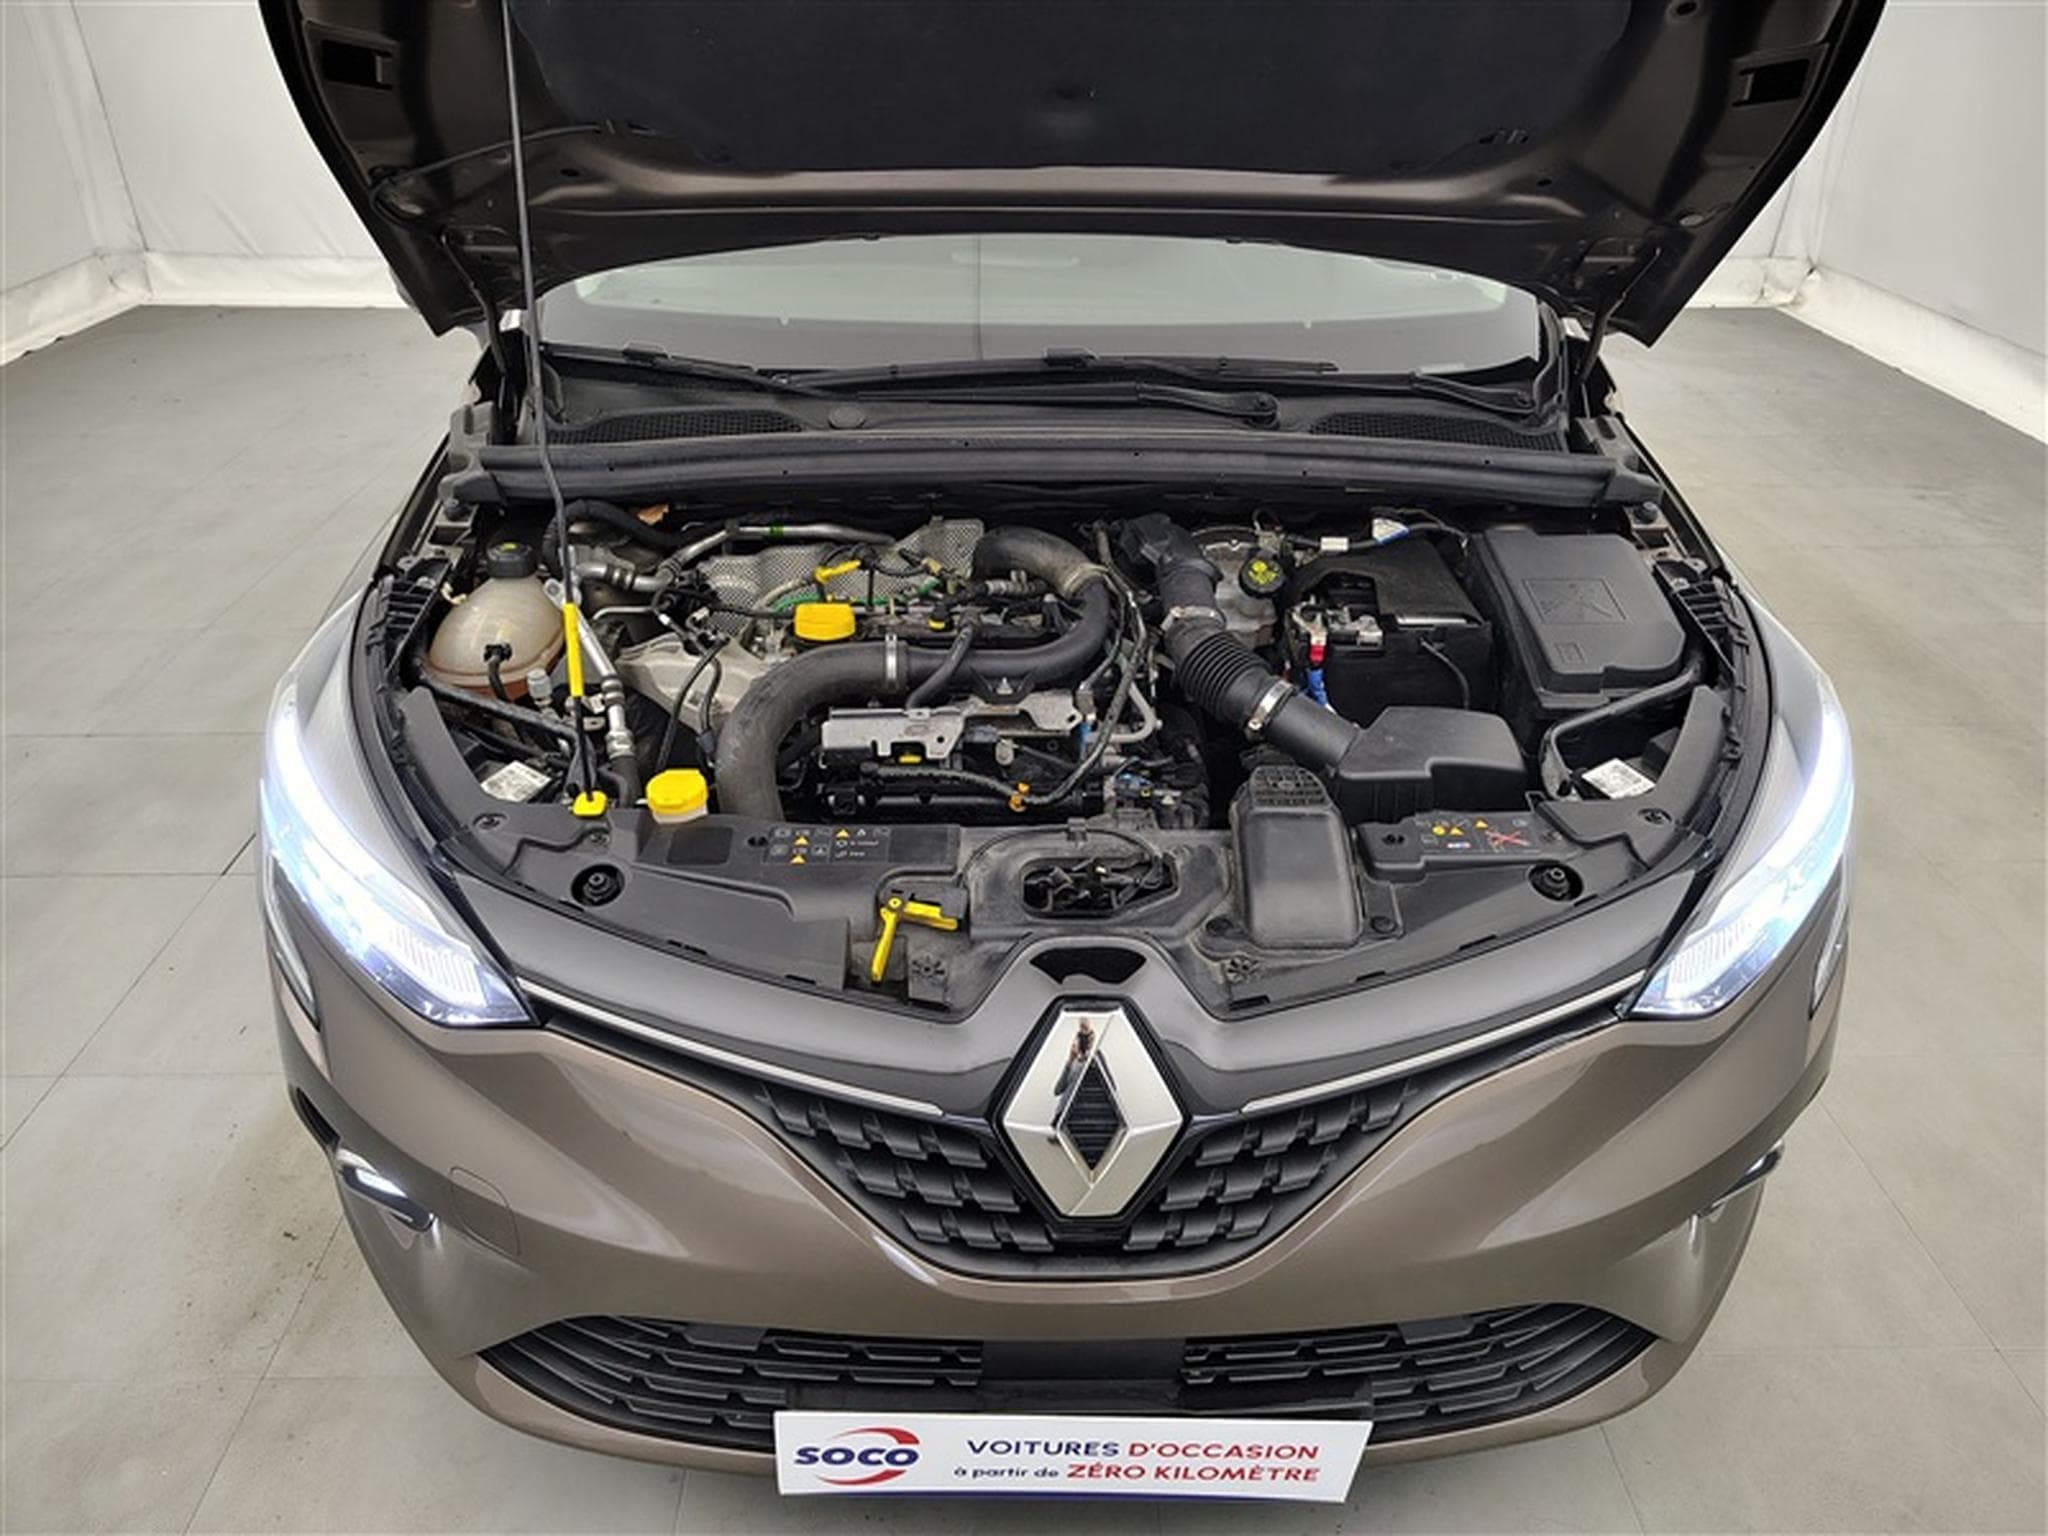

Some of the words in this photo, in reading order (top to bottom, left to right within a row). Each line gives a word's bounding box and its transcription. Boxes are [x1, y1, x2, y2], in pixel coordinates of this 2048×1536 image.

[794, 1446, 920, 1467] SOCO
[967, 1440, 1119, 1457] VOITURES
[1128, 1442, 1320, 1460] D'OCCASION
[971, 1466, 1029, 1480] partir
[1033, 1466, 1060, 1478] de
[1066, 1462, 1147, 1480] ZÉRO
[1154, 1464, 1322, 1482] KILOMÈTRE
